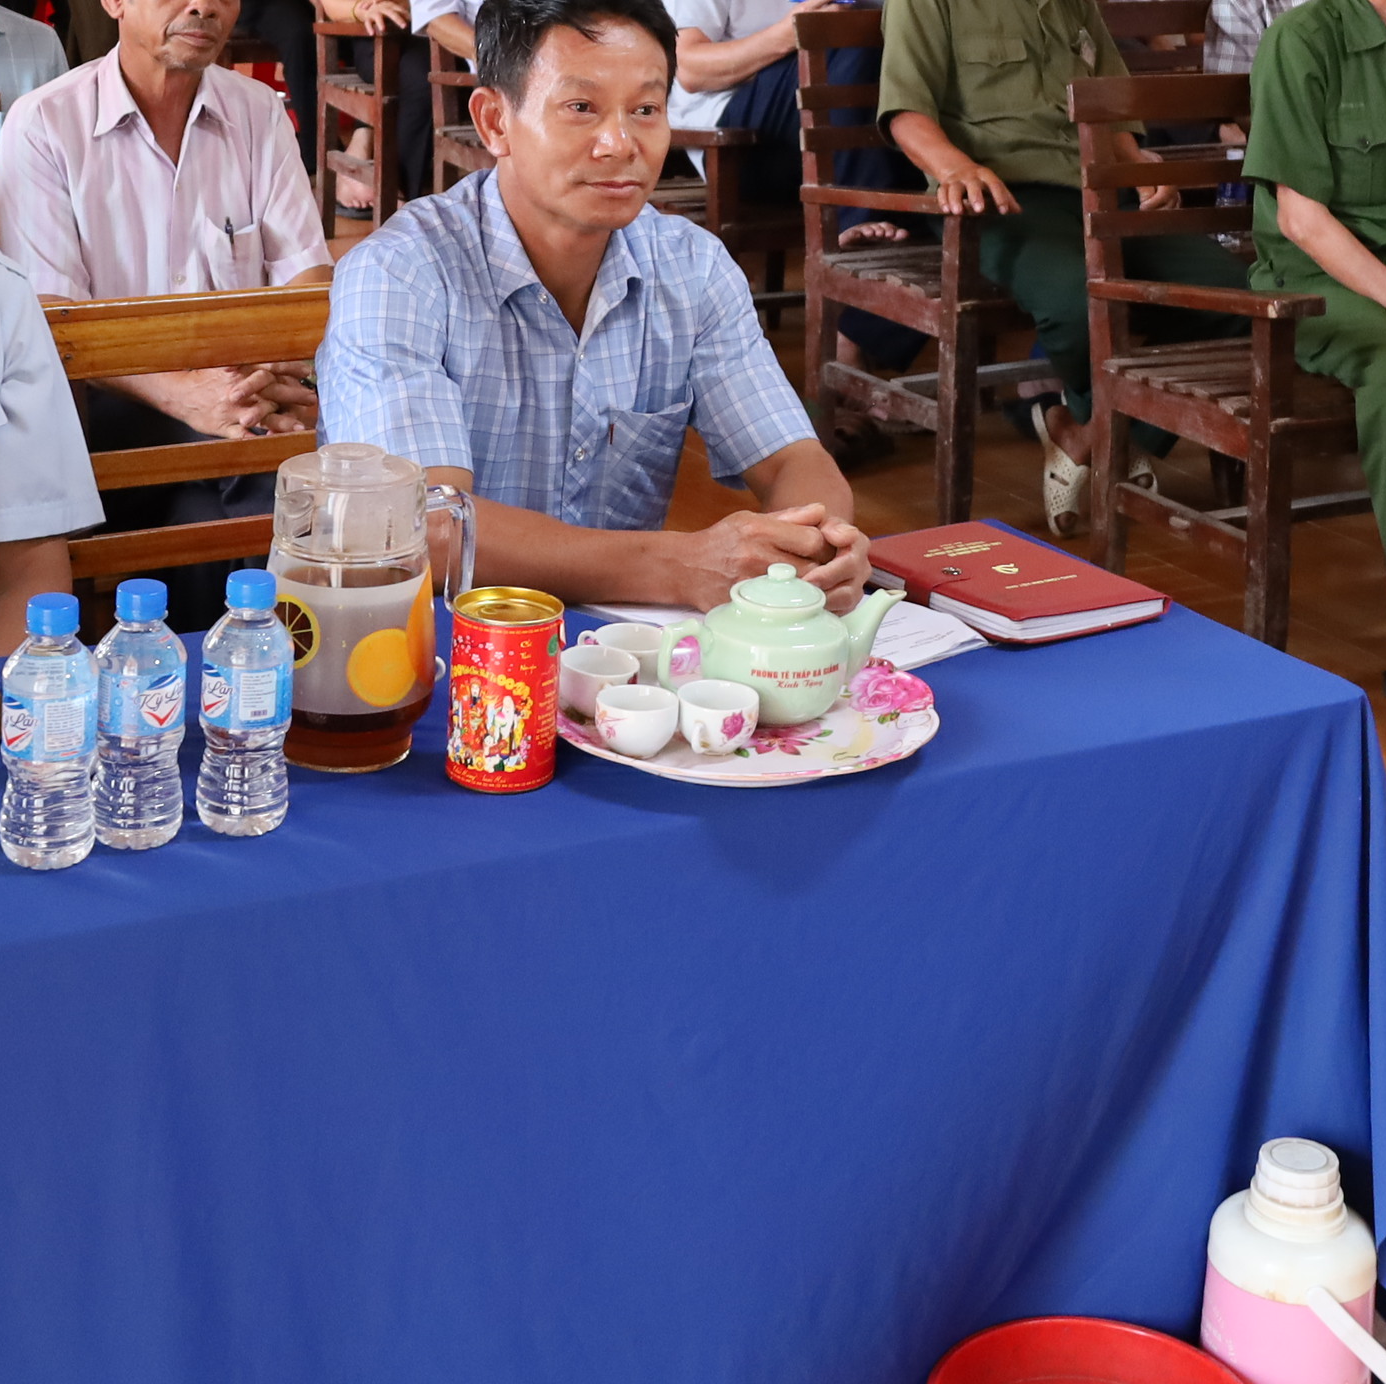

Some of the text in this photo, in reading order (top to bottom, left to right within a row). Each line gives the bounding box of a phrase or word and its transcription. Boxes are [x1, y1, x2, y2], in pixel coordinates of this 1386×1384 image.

[751, 668, 778, 679] PHÒNG
[780, 671, 790, 679] TẾ
[792, 669, 811, 679] THẤP
